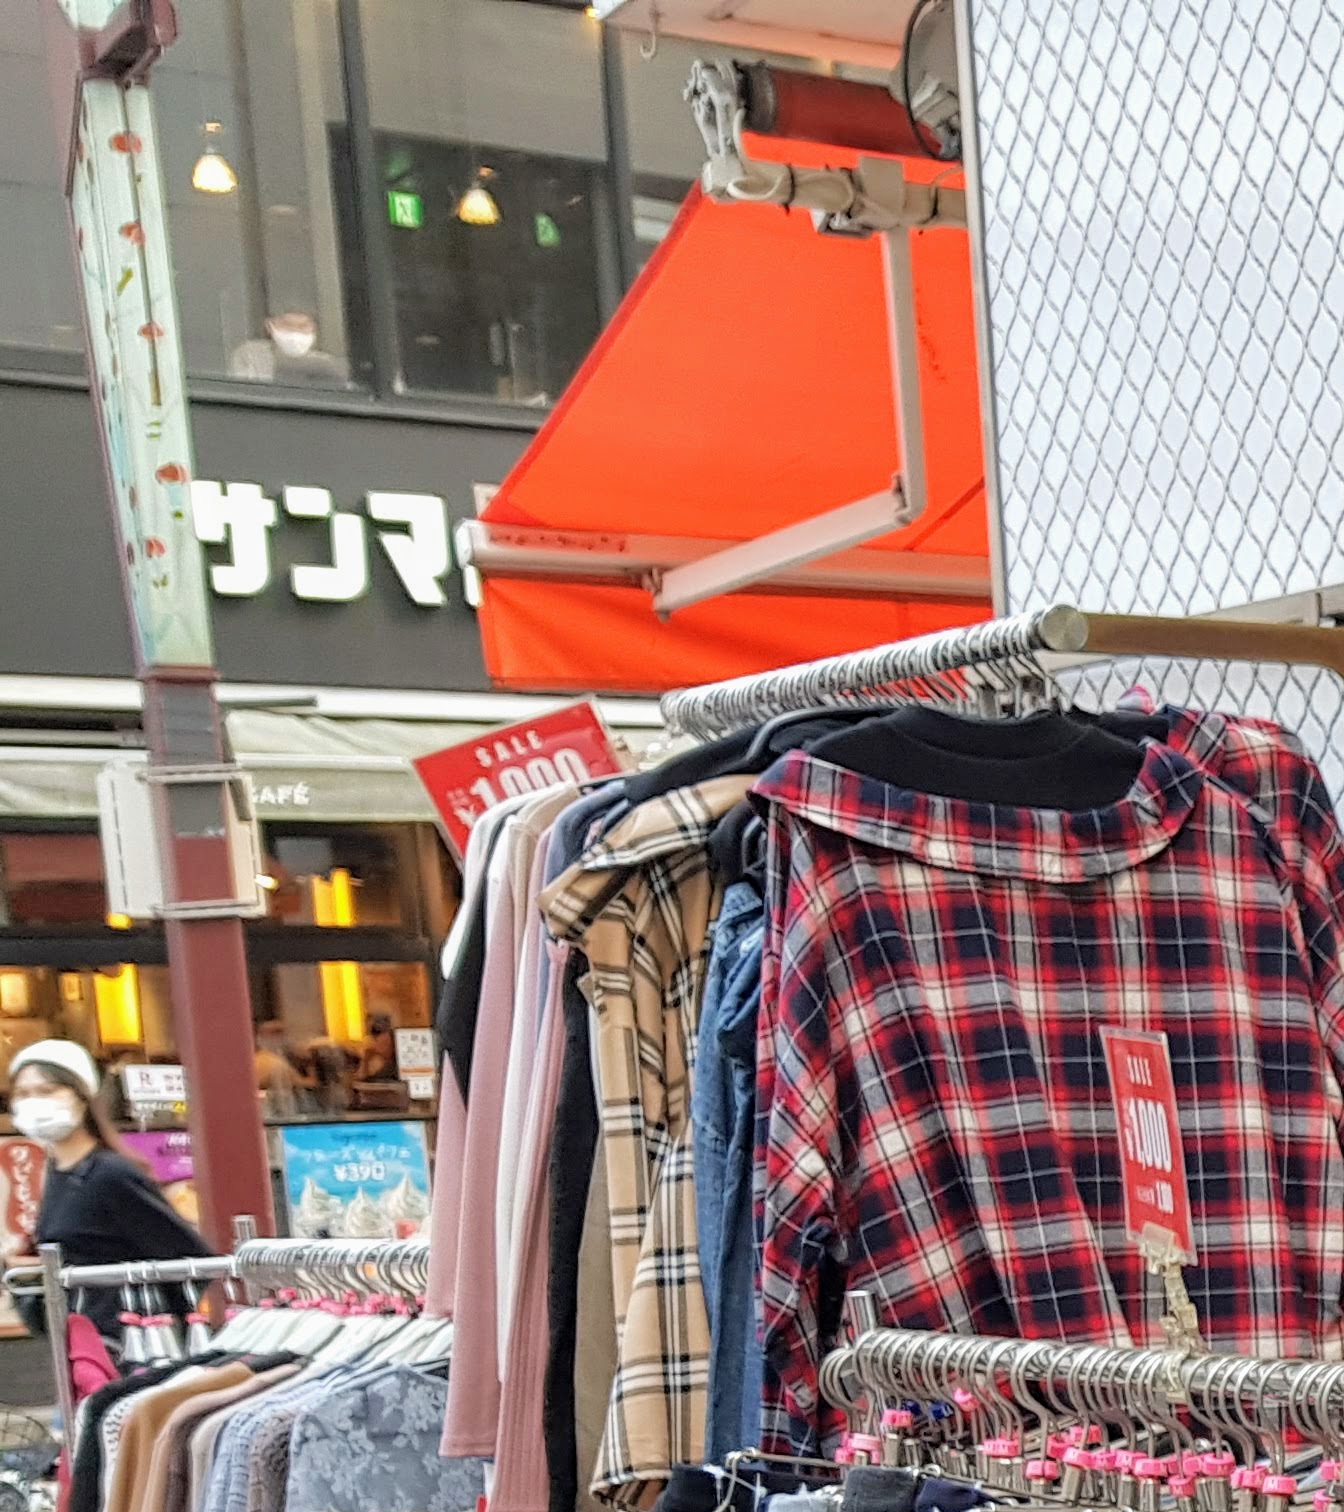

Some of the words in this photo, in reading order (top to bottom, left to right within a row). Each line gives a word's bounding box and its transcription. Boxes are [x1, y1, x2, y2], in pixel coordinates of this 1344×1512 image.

[190, 480, 482, 607] サンマ
[475, 729, 543, 768] SALE
[1266, 1477, 1279, 1490] M
